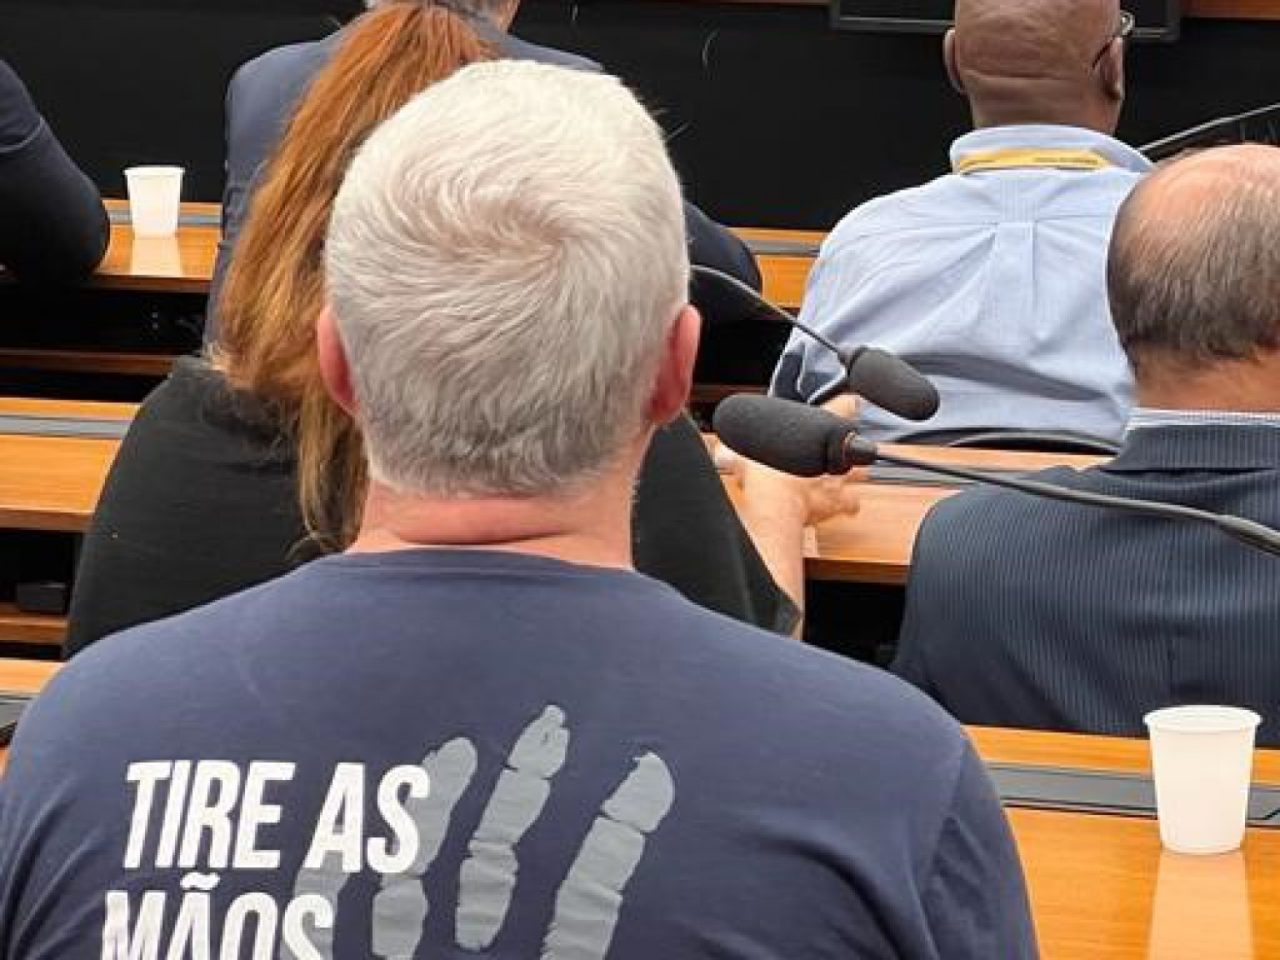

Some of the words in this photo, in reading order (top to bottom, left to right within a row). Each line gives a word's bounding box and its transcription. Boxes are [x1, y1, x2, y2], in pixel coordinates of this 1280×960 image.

[122, 760, 296, 870] TIRE
[302, 761, 431, 874] AS
[100, 871, 334, 960] MÃOS
